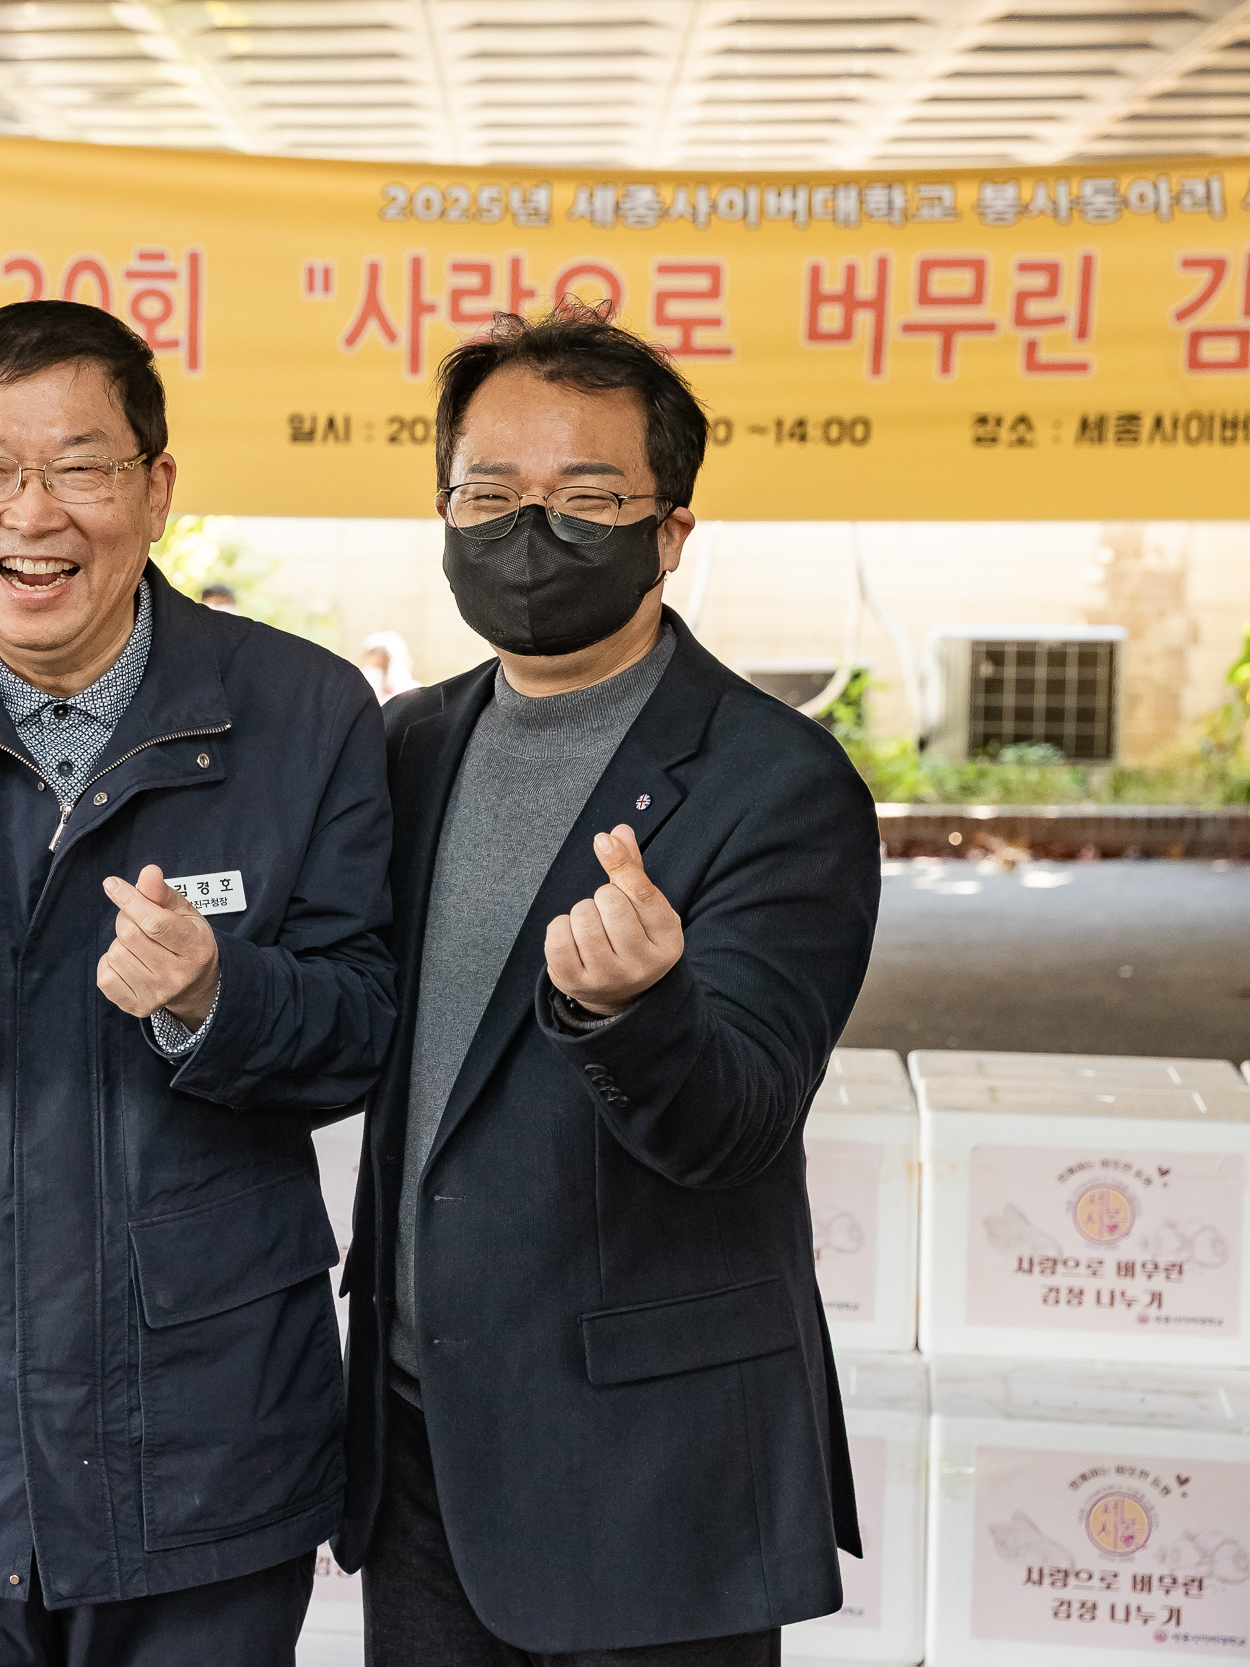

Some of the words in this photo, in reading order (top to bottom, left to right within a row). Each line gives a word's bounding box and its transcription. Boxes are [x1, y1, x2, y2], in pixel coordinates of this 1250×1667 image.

[380, 182, 552, 228] 2025년
[567, 182, 960, 229] 세종사이버대학교
[976, 173, 1229, 226] 봉사동아리
[804, 252, 1097, 377] 버무린
[287, 412, 352, 445] 일시
[972, 411, 1037, 448] 장소
[191, 896, 229, 909] 진구청장
[1022, 1564, 1122, 1593] 사랑으로
